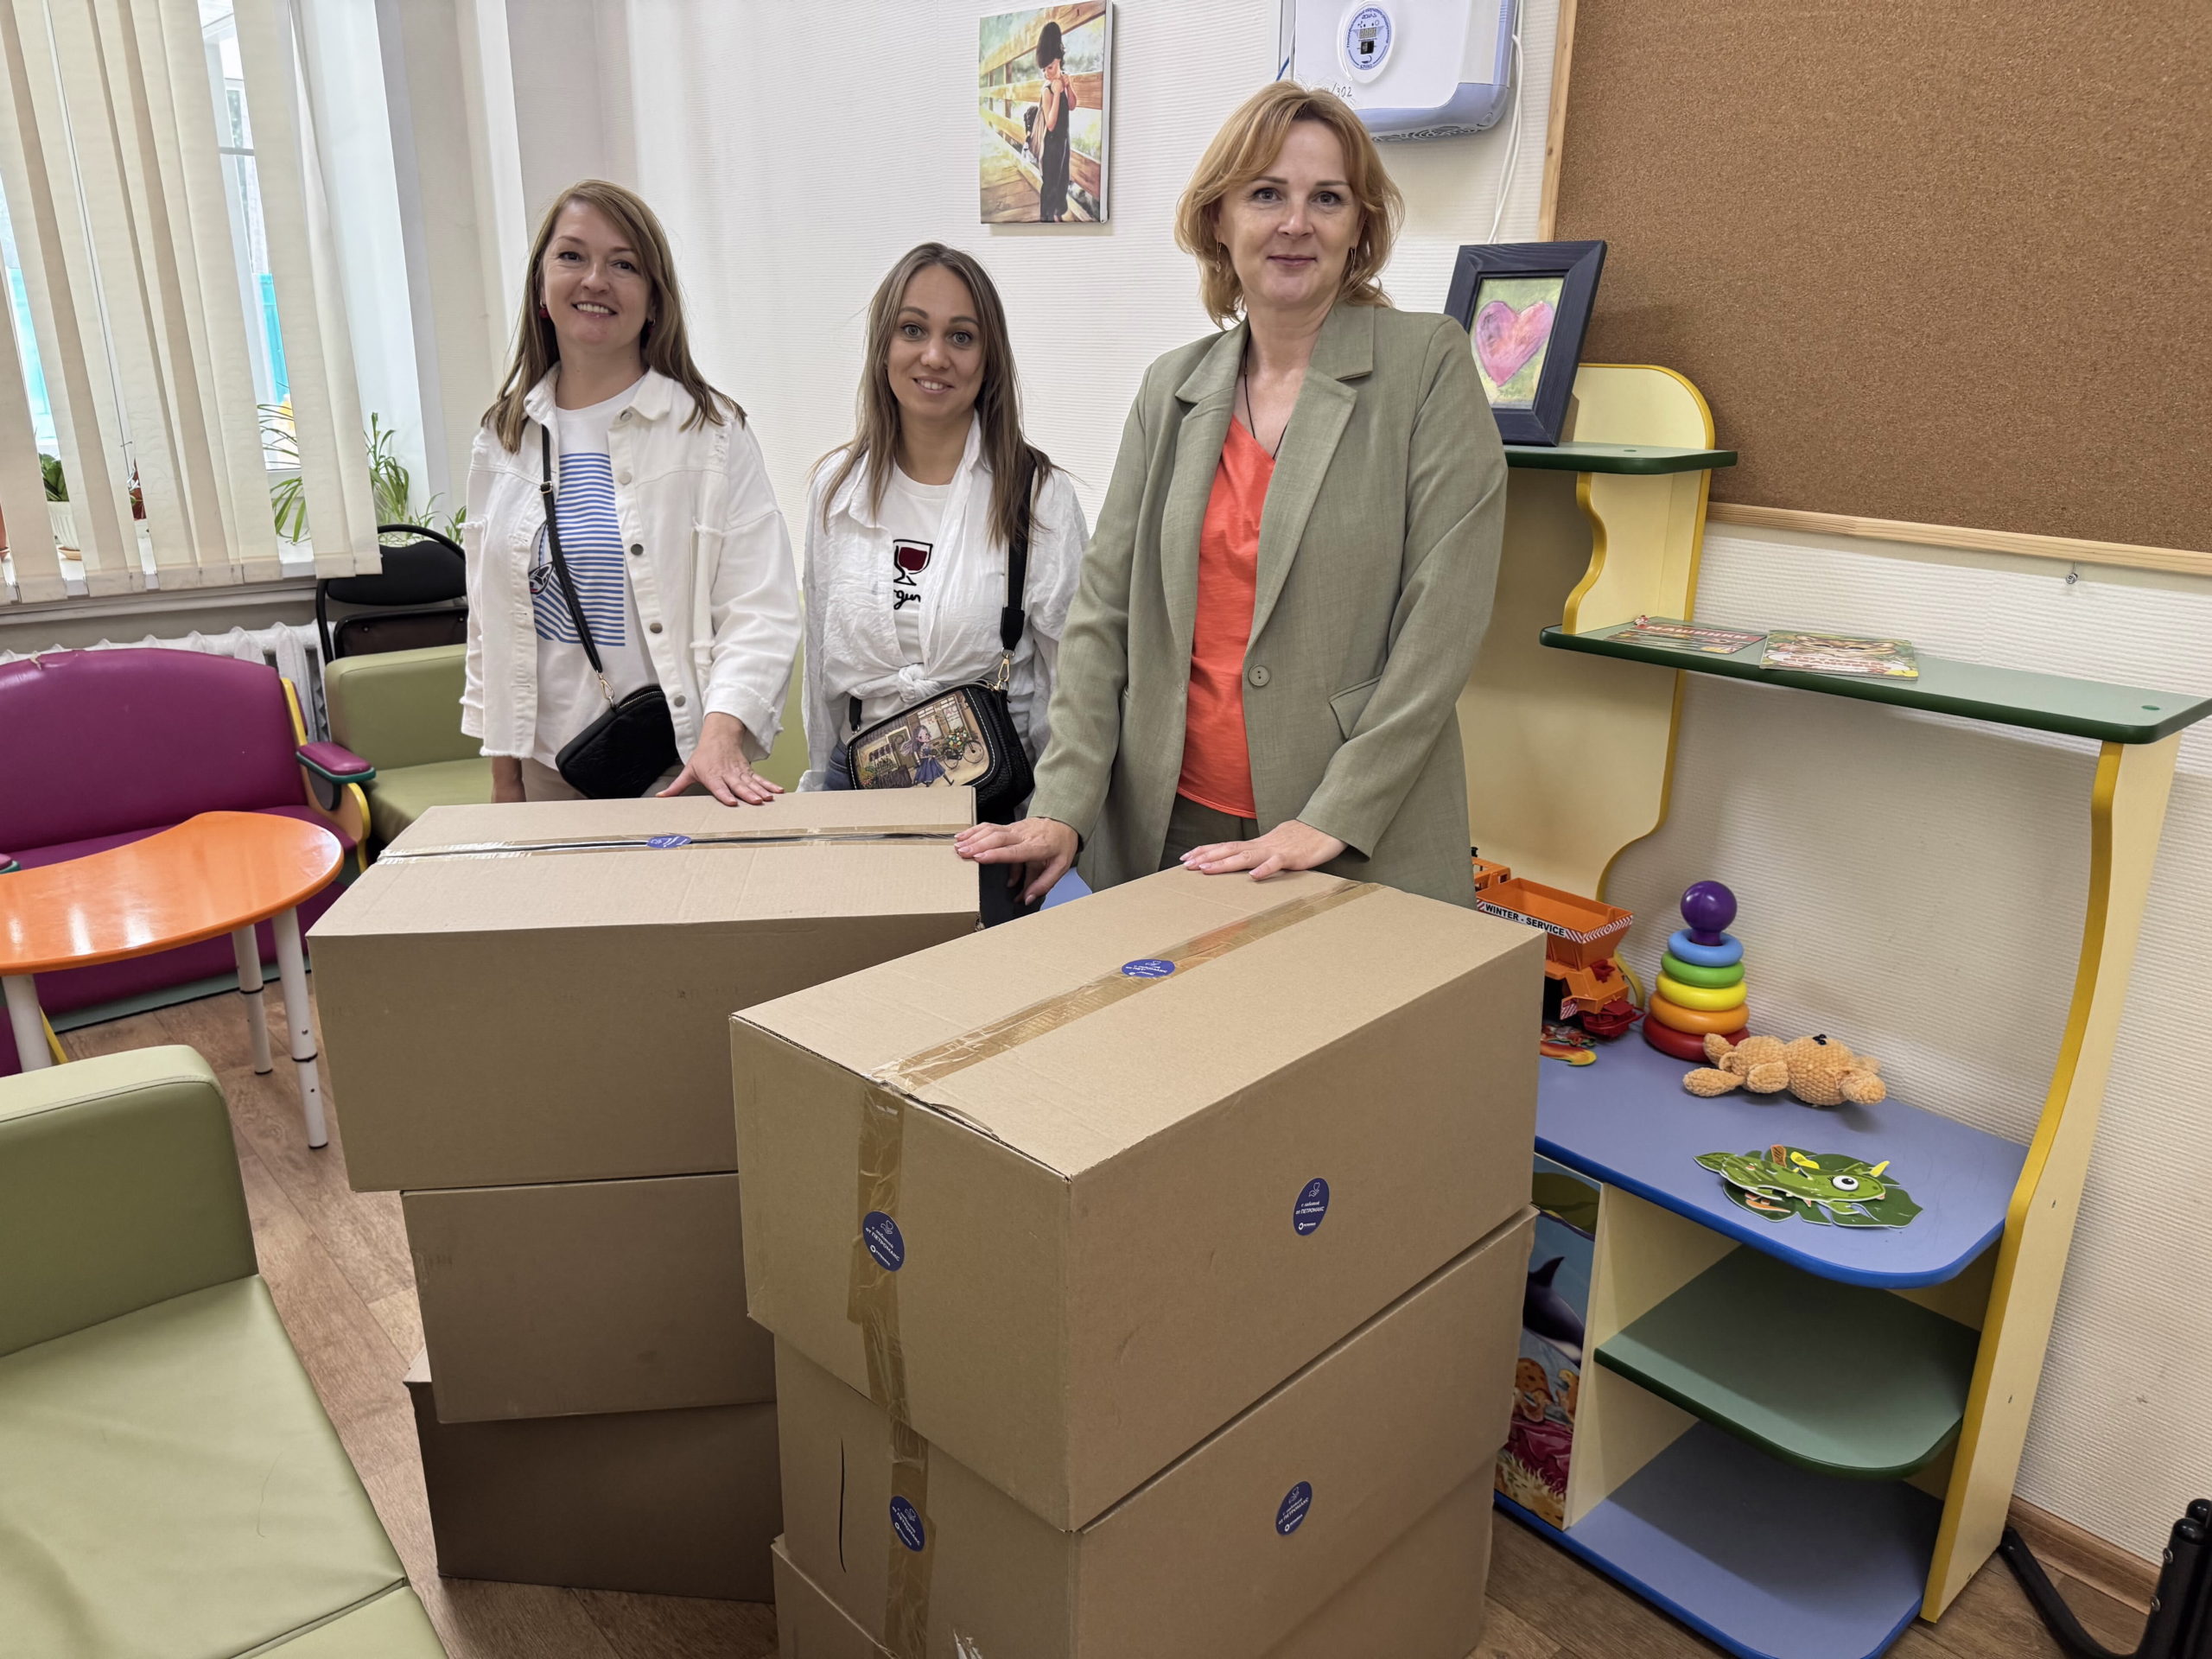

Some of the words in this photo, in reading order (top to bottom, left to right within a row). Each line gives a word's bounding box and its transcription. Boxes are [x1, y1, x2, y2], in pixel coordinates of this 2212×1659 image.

[1485, 904, 1519, 921] WINTER
[1526, 918, 1565, 936] SERVICE
[872, 1231, 900, 1262] ПЕТРОМАКС
